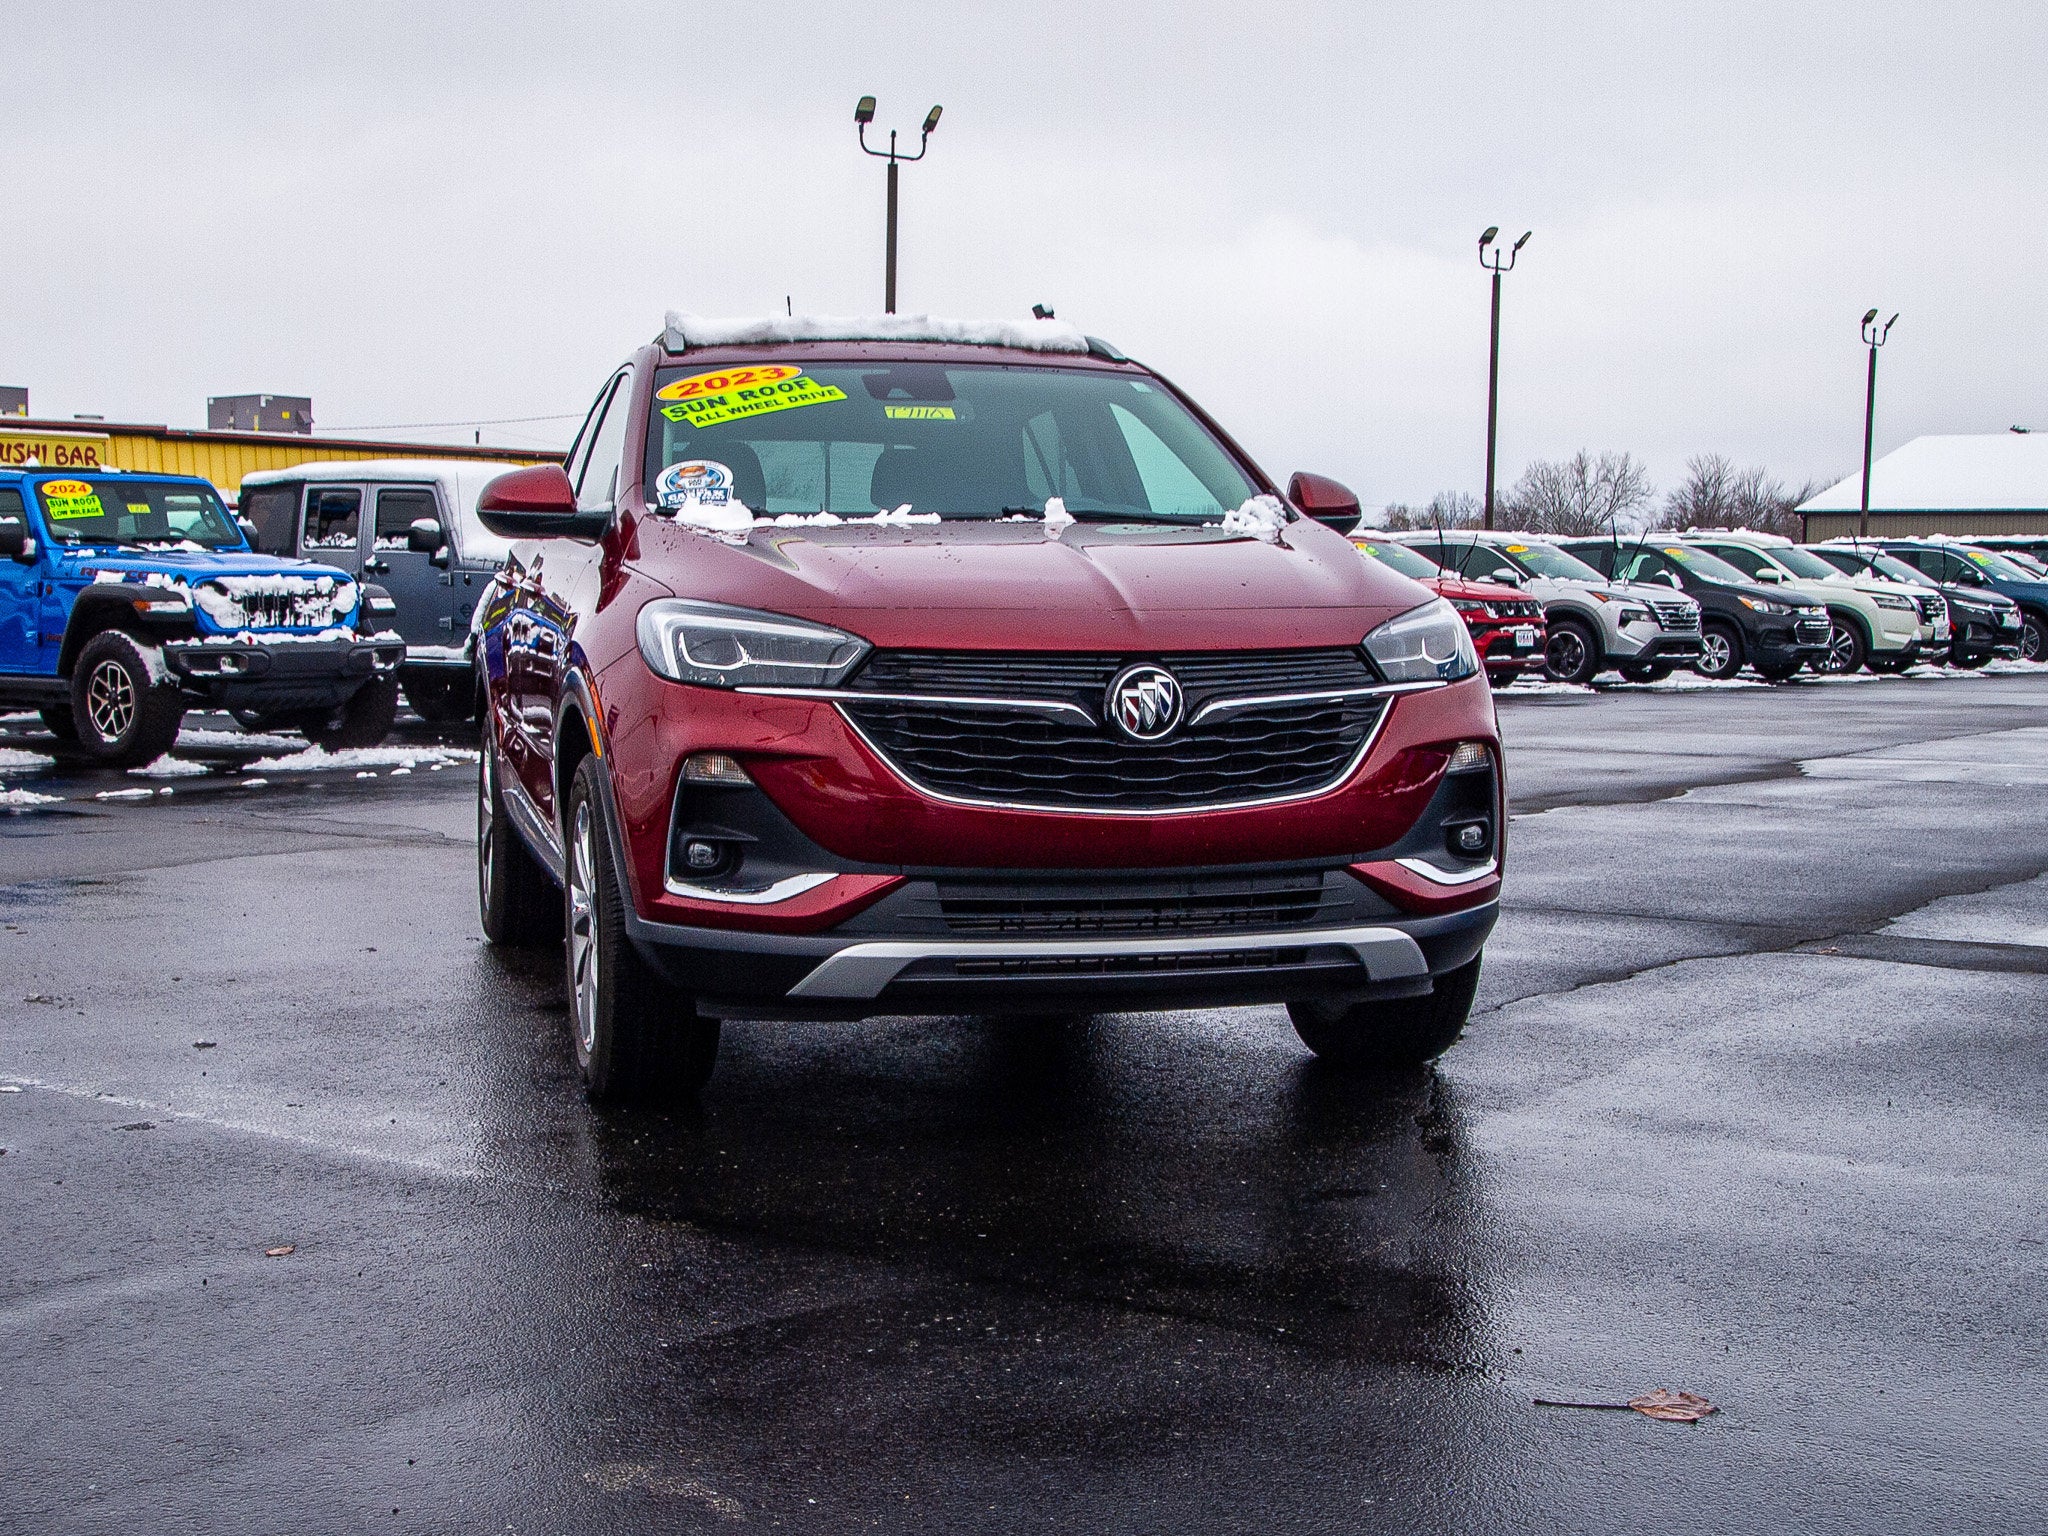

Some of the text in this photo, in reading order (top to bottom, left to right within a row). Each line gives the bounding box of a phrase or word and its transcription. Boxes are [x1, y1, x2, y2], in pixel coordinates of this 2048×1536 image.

[676, 367, 787, 398] 2023
[669, 378, 809, 419] SUN ROOF
[695, 388, 838, 424] ALL WHEEL DRIVE
[55, 444, 100, 467] BAR
[49, 484, 87, 494] 2024
[49, 497, 97, 508] SUN ROOF
[53, 507, 101, 518] LOW MILEAGE
